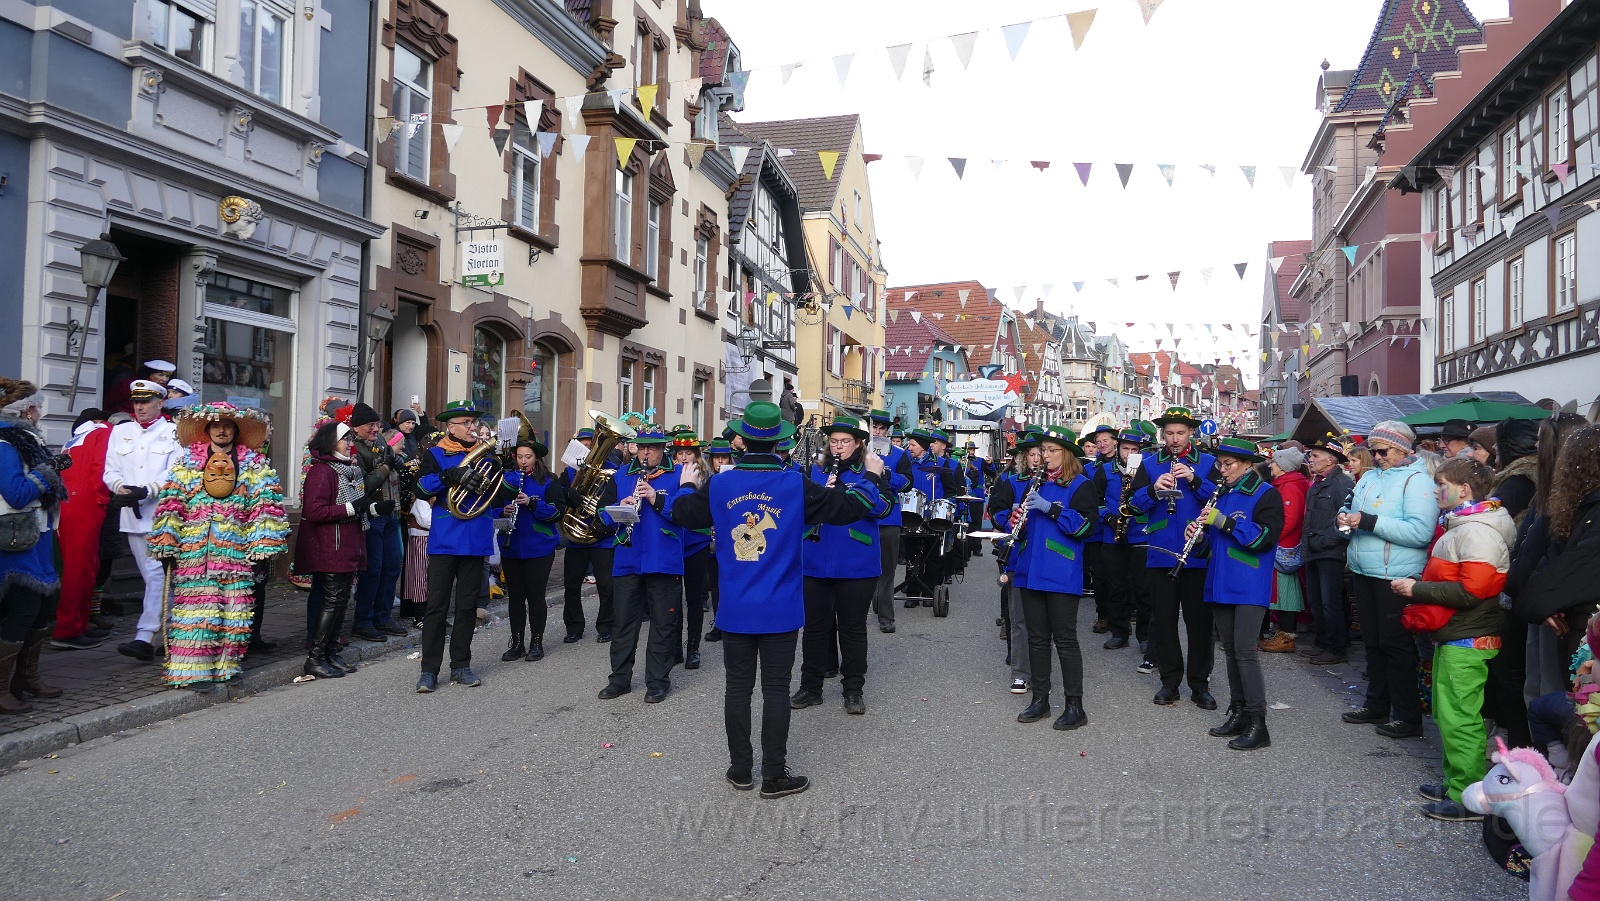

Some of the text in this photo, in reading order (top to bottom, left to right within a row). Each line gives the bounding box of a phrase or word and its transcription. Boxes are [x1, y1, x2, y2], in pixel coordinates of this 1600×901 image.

[468, 243, 498, 254] Bistro
[467, 258, 499, 271] Florian
[945, 395, 979, 415] Entersbach
[726, 491, 773, 510] Entersbacher
[757, 503, 782, 518] Musik
